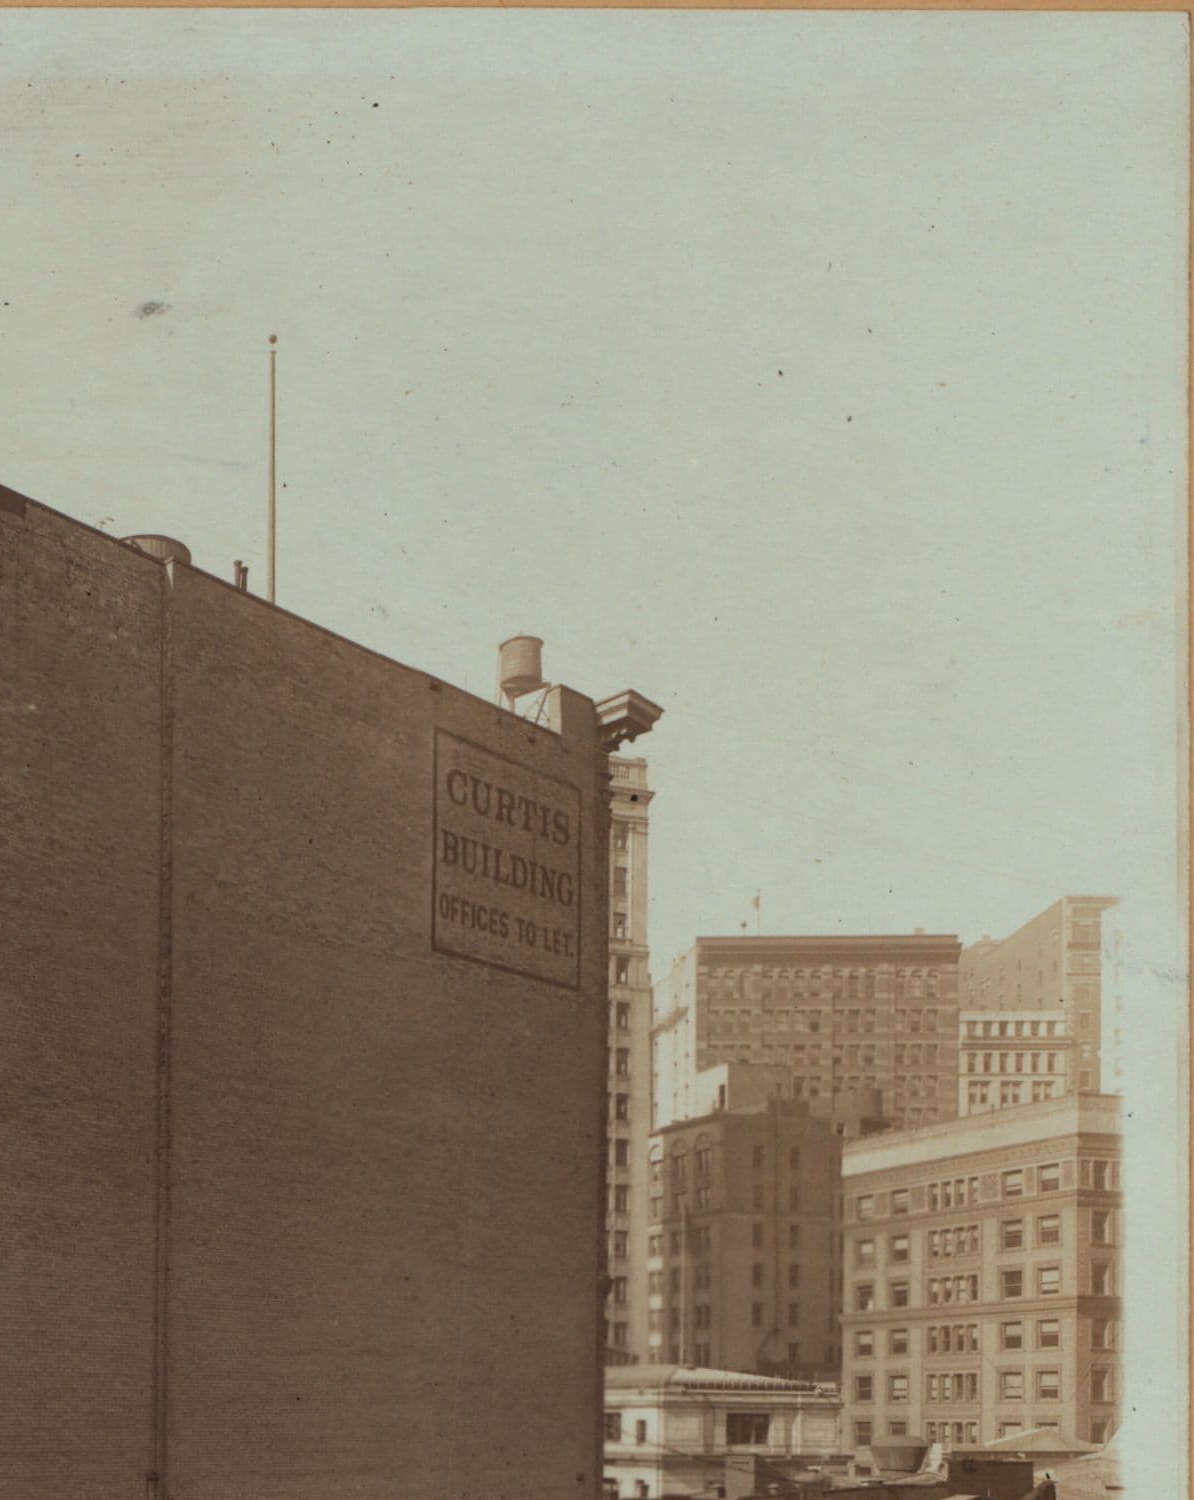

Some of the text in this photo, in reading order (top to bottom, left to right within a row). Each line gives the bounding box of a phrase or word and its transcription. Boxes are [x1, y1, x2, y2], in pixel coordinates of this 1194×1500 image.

[445, 768, 571, 846] CURTIS
[440, 828, 575, 907] BUILDING
[438, 892, 509, 939] OFFICES
[515, 917, 537, 946] TO
